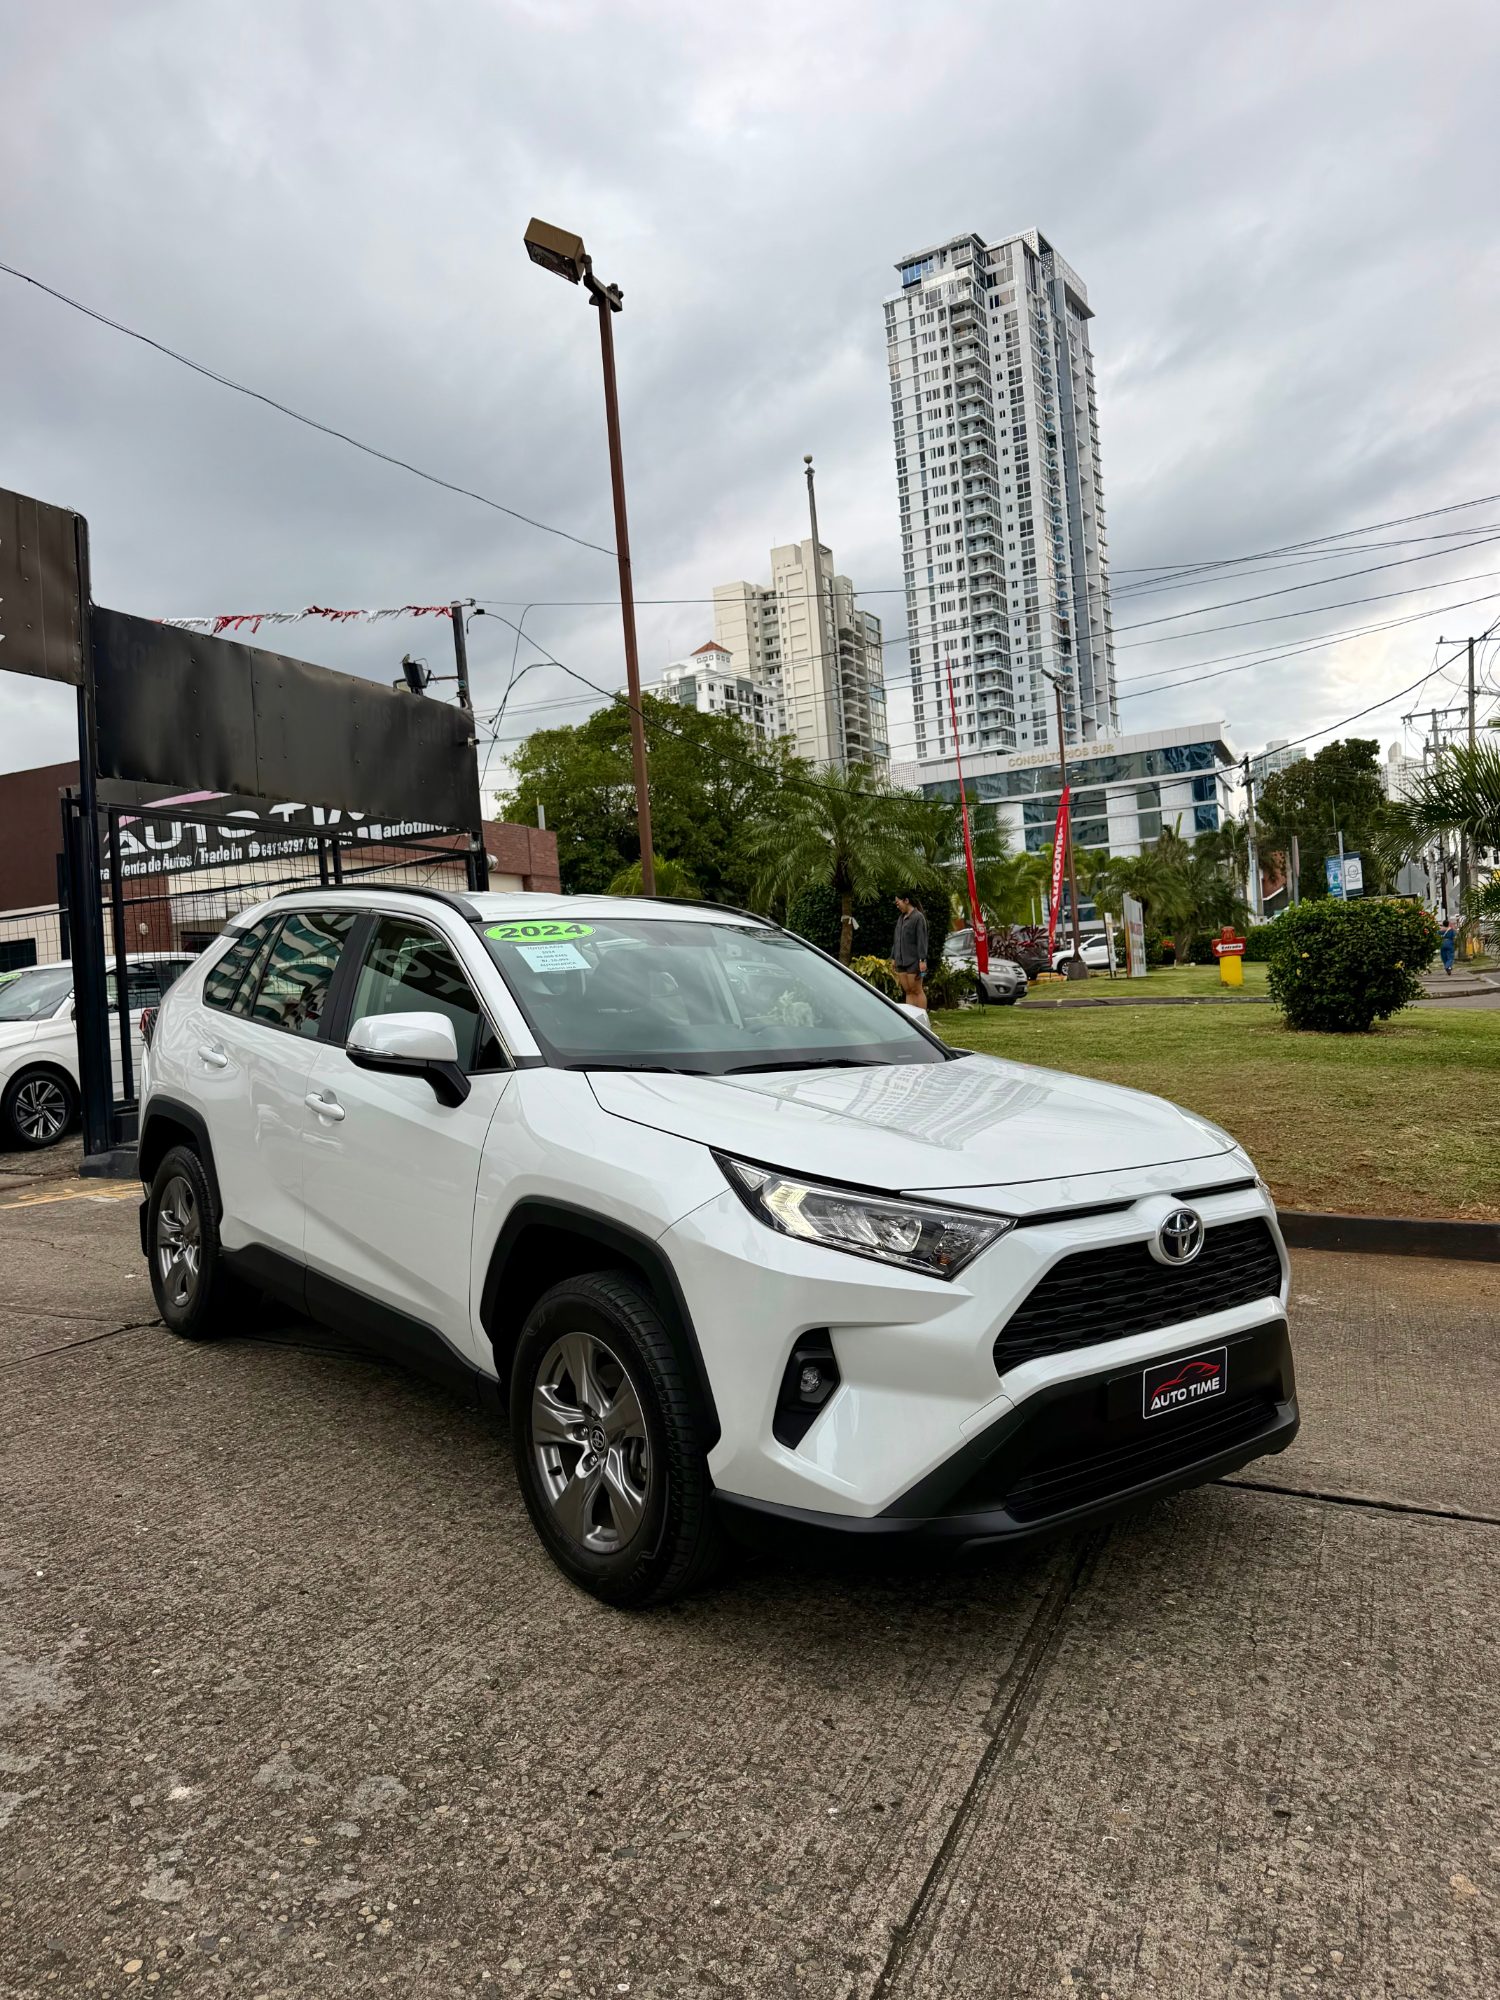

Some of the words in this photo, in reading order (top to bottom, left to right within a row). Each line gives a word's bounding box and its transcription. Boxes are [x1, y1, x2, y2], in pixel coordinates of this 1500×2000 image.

[1008, 747, 1089, 767] CONSULTORIOS
[1092, 744, 1115, 755] SUR
[148, 856, 161, 873] de
[162, 853, 192, 871] Autos
[199, 845, 230, 865] Trade
[499, 925, 585, 938] 2024
[1151, 1388, 1187, 1410] AUTO
[1189, 1377, 1220, 1397] TIME
